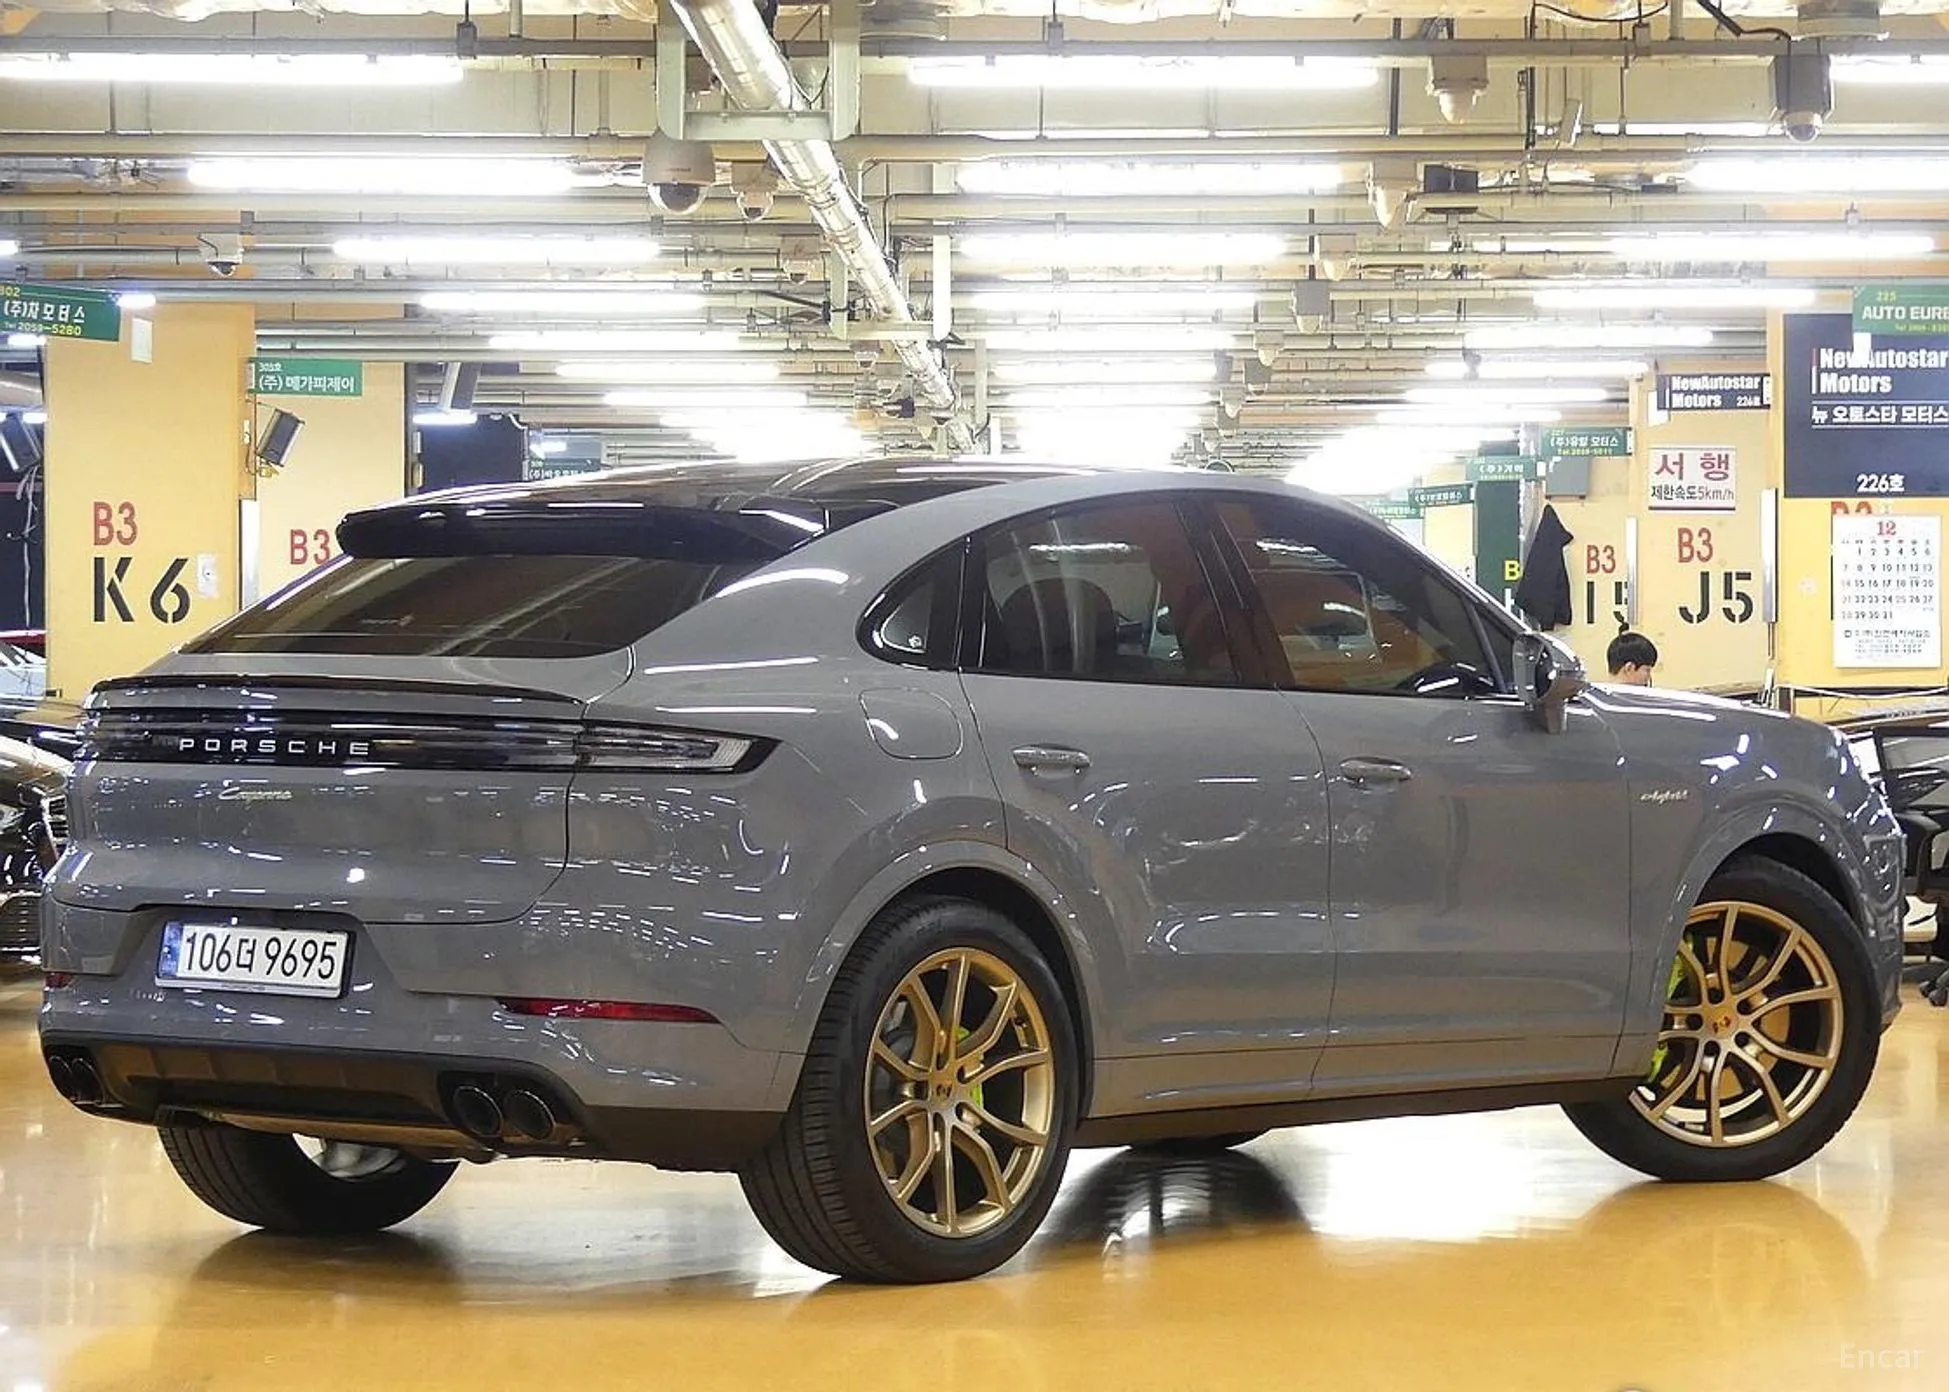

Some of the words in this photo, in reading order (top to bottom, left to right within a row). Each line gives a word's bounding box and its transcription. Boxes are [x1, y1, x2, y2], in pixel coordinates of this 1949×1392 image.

[1862, 306, 1906, 320] AUTO
[1820, 372, 1892, 394] Motors
[1672, 393, 1722, 408] Motors
[1812, 405, 1828, 424] 뉴
[1900, 405, 1949, 424] 모터스
[1857, 473, 1905, 493] 226호
[93, 501, 138, 546] B3
[1877, 520, 1897, 536] 12
[290, 528, 331, 565] B3
[1677, 526, 1714, 564] B3
[1586, 544, 1617, 575] B3
[1678, 571, 1754, 624] J5
[178, 738, 369, 756] PORSCHE
[186, 931, 257, 974] 106더
[264, 936, 337, 980] 9695
